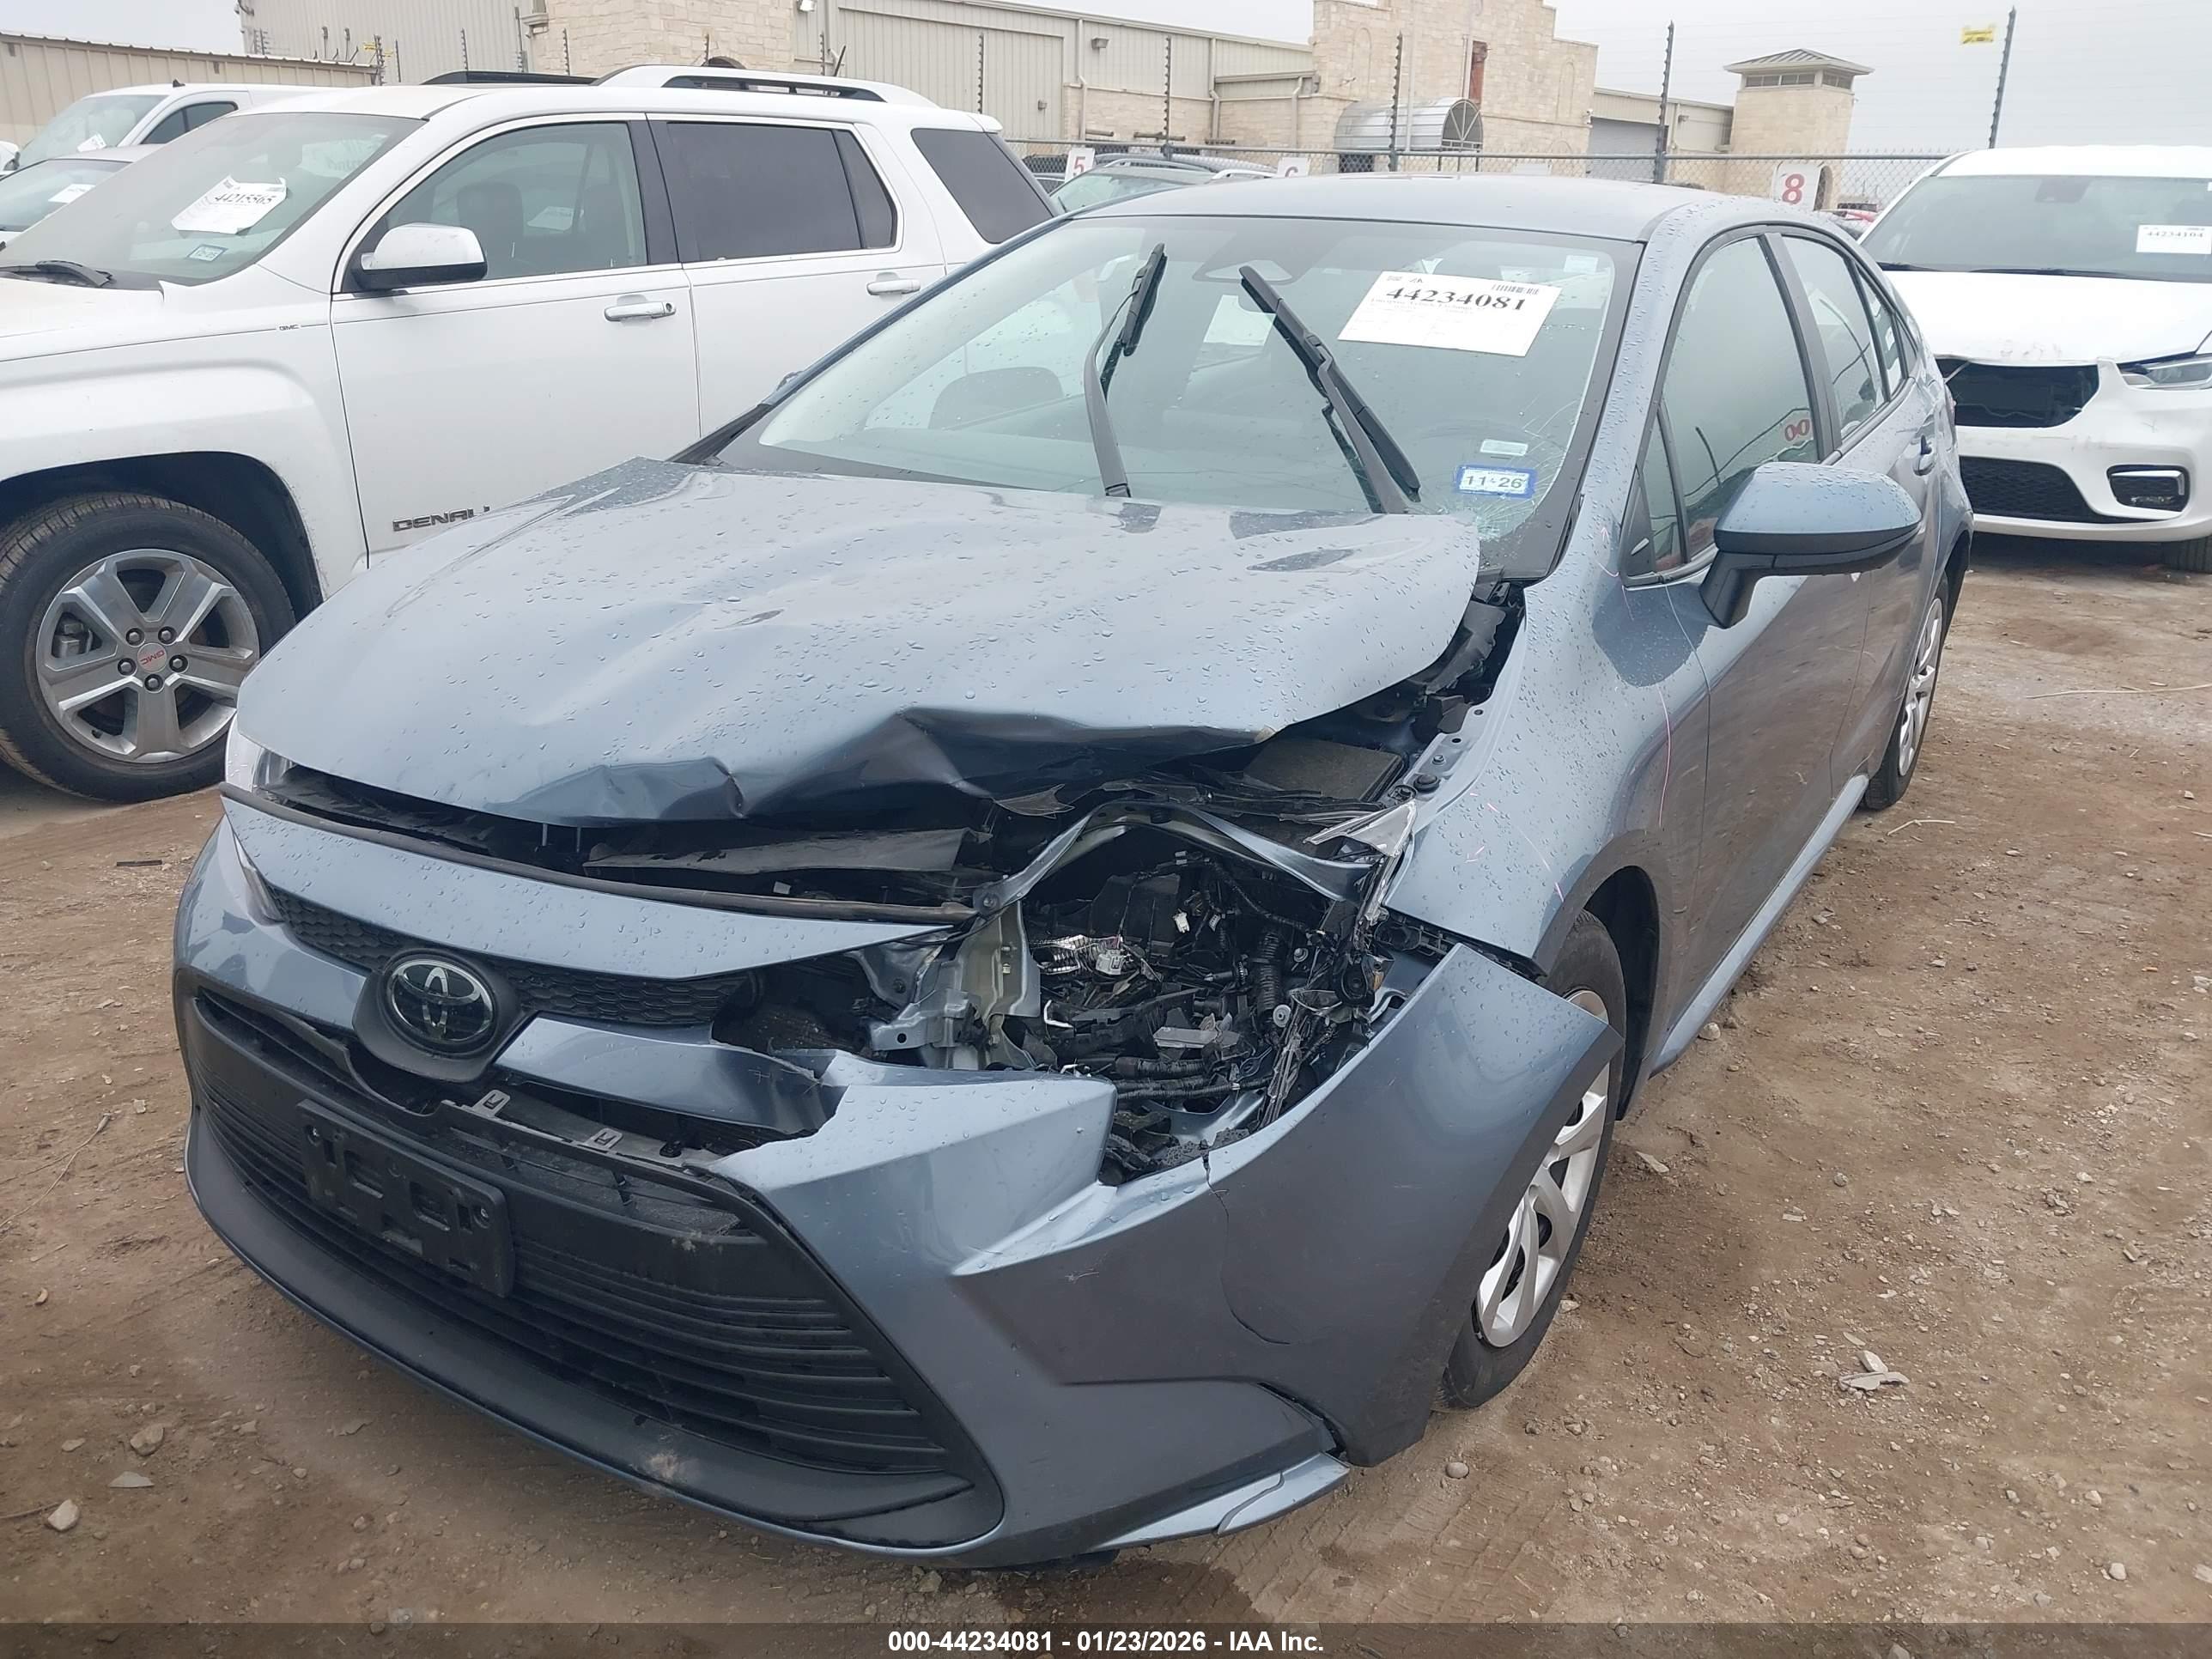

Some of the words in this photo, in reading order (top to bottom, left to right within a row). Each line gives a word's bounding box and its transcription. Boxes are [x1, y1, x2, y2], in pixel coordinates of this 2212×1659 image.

[1782, 173, 1805, 204] 8
[1386, 287, 1526, 311] 44234081
[140, 649, 165, 665] GMC
